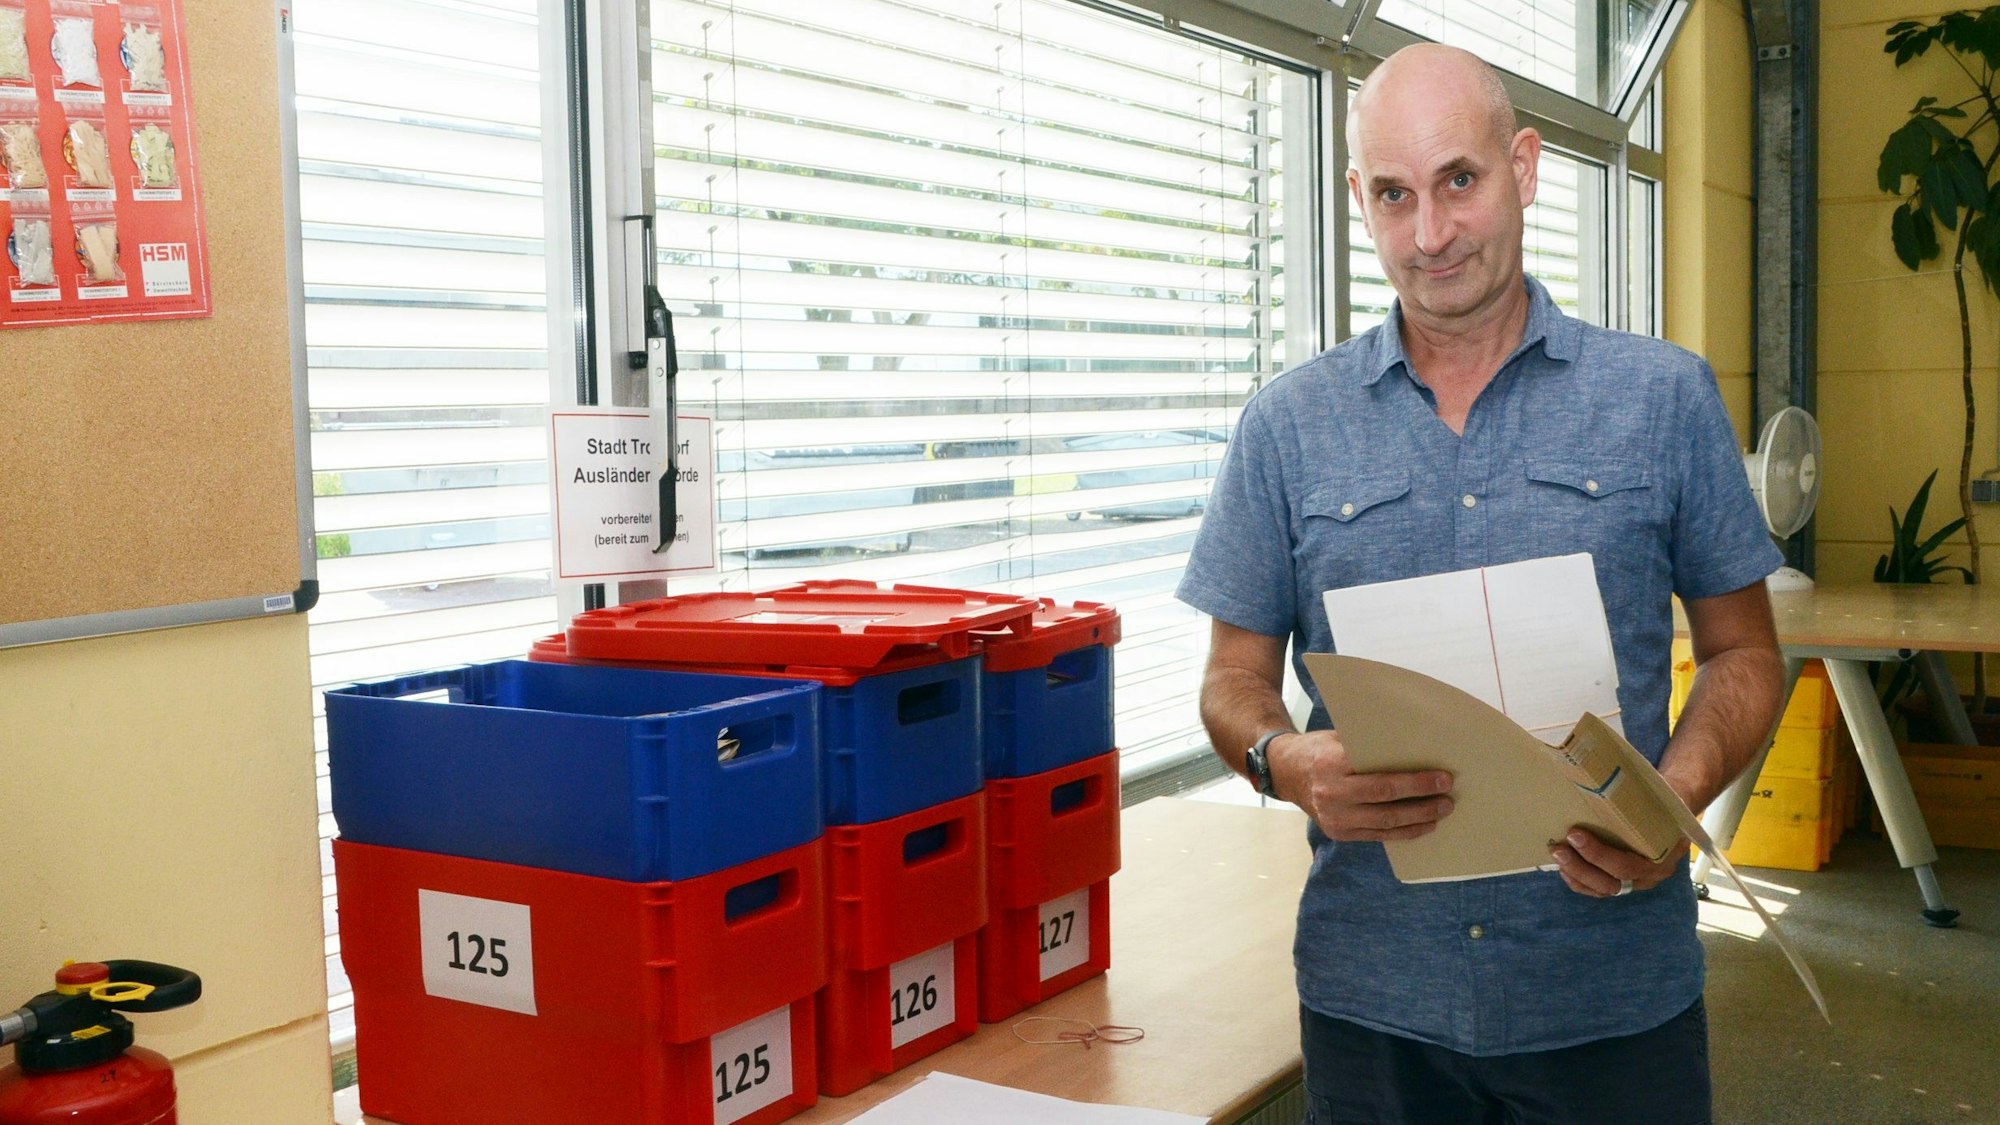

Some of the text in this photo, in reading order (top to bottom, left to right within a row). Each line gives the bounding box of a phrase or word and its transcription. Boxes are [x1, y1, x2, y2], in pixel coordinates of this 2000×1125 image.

[142, 246, 186, 262] HSM
[587, 438, 690, 455] Stadt Trorf
[573, 466, 699, 484] Ausländerörde
[594, 533, 649, 548] (bereit zum
[1039, 910, 1075, 954] 127
[447, 931, 509, 977] 125
[891, 974, 938, 1026] 126
[715, 1043, 770, 1104] 125
